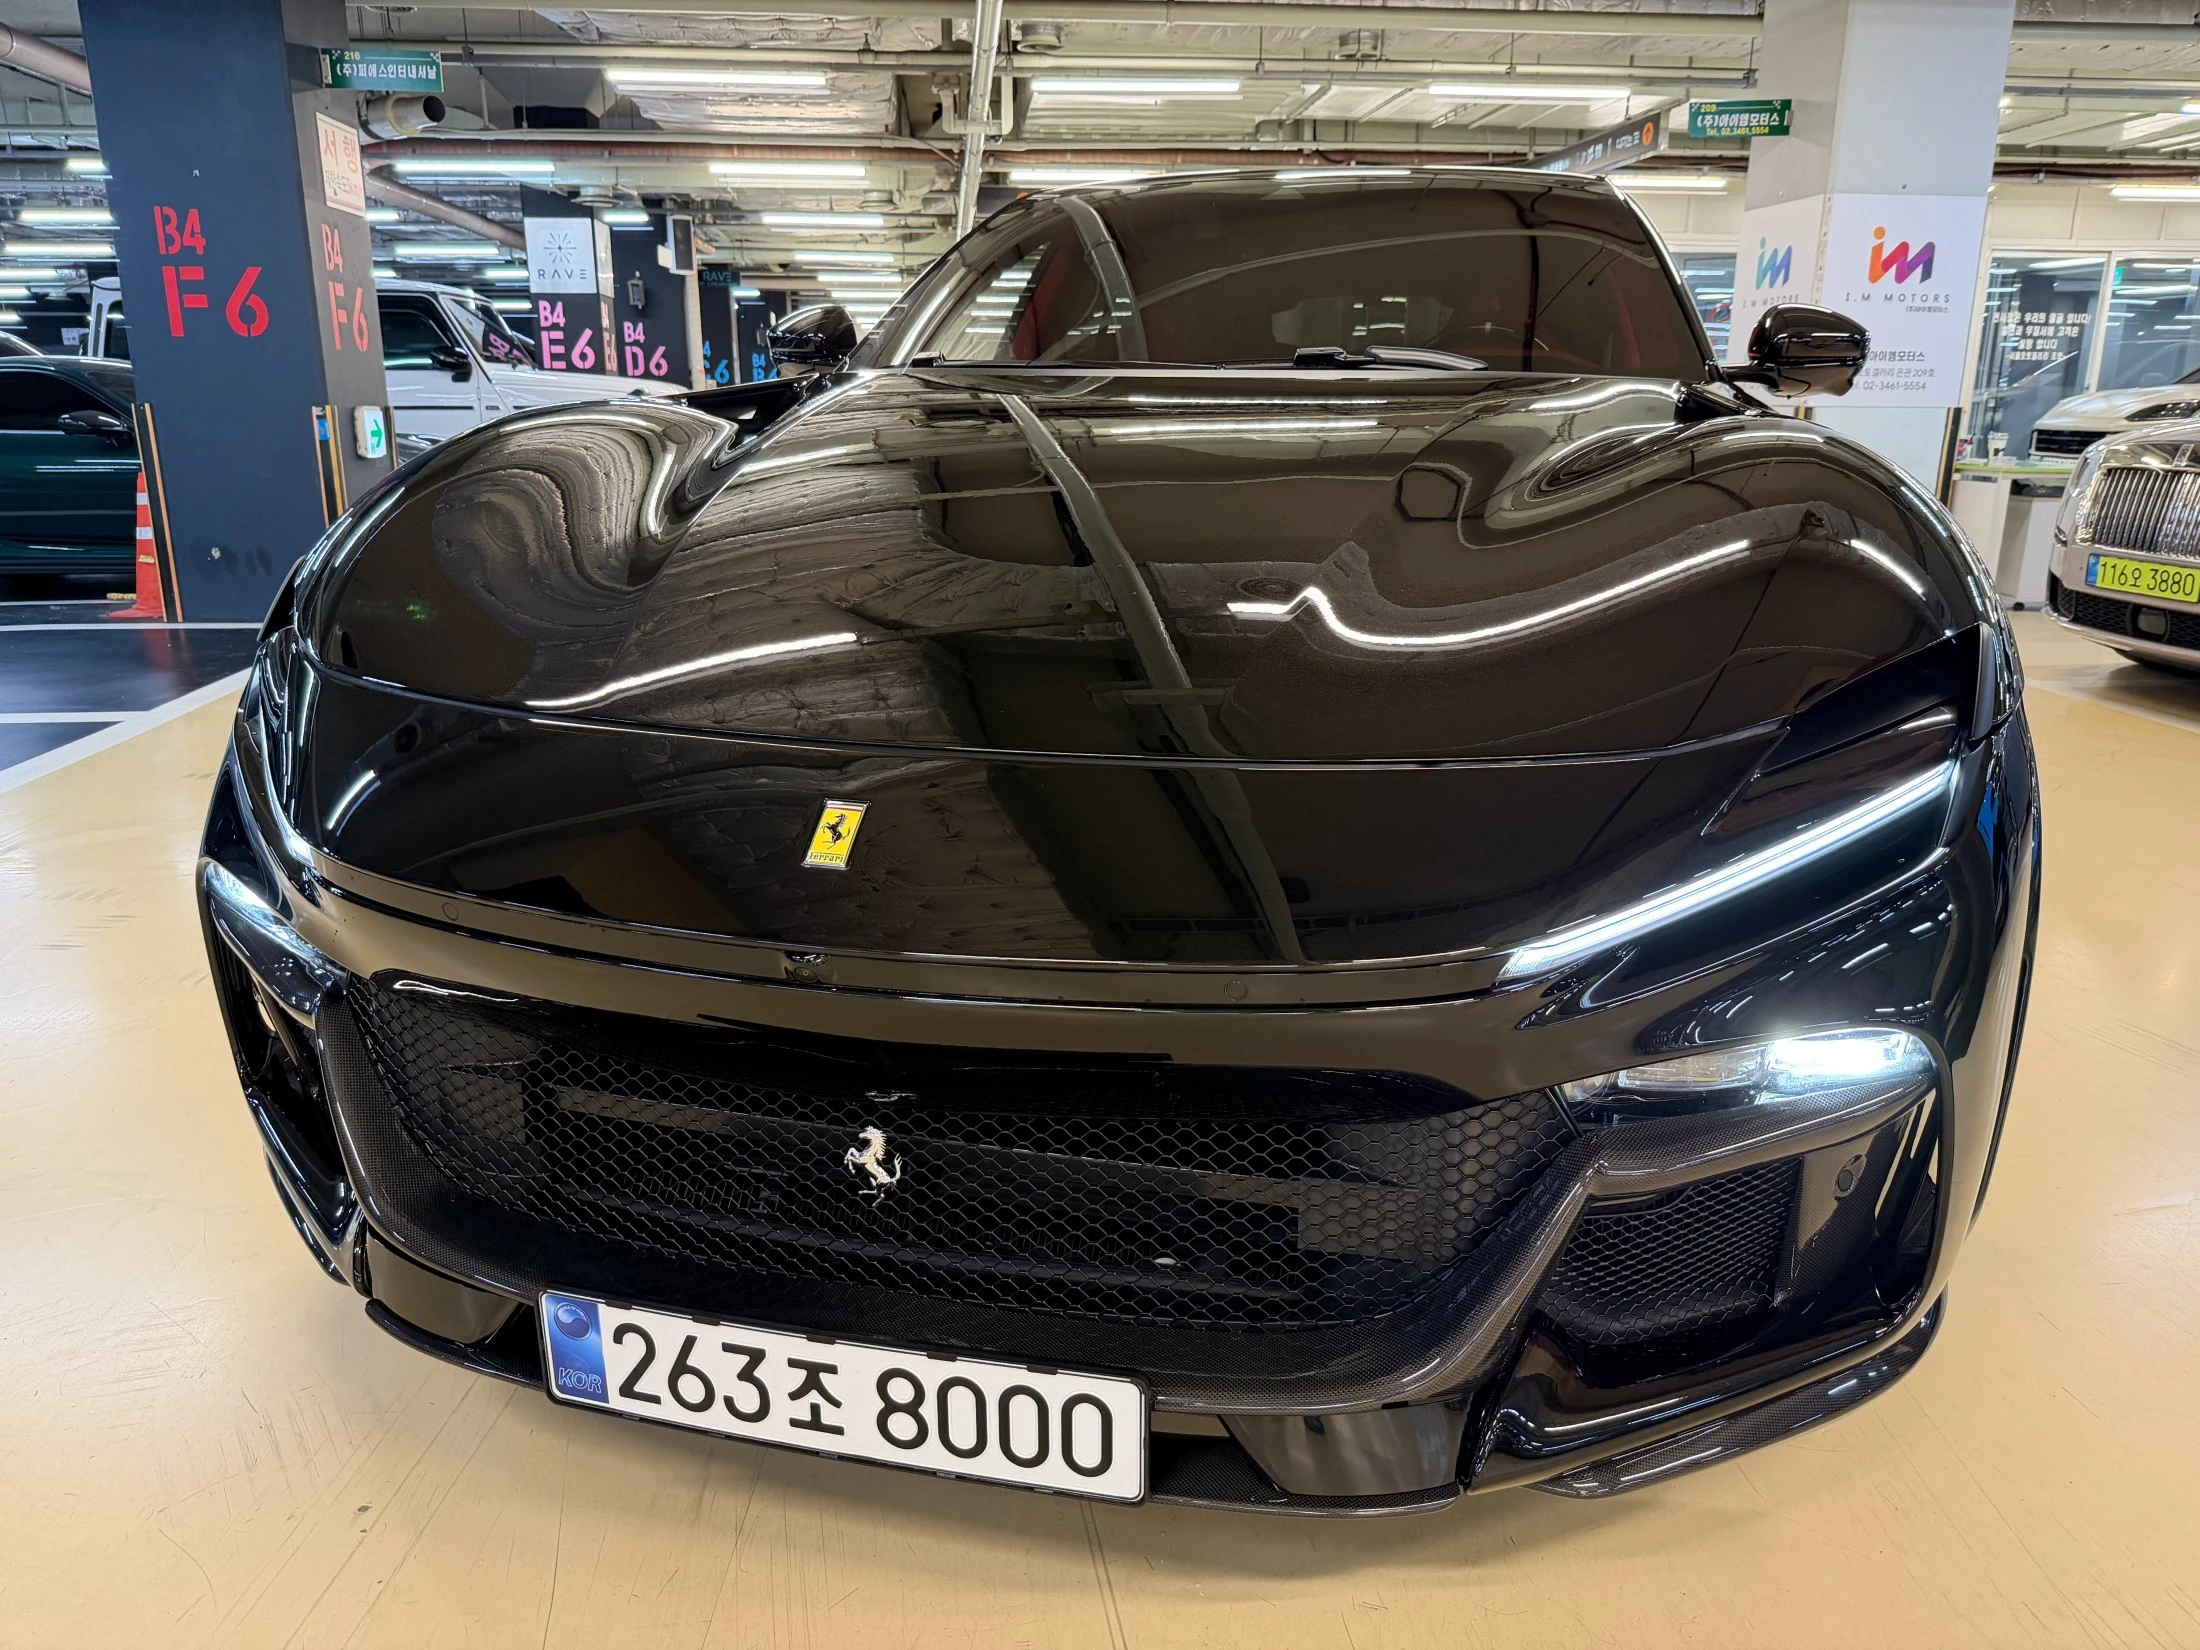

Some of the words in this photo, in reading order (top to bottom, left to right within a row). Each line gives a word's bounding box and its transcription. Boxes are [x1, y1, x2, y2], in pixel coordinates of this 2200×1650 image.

[344, 51, 360, 60] 216
[1700, 104, 1717, 113] 209
[154, 206, 206, 254] B4
[322, 224, 343, 274] B4
[538, 269, 587, 280] RAVE
[703, 271, 732, 281] RAVE
[1884, 293, 1950, 303] MOTORS
[538, 300, 565, 327] B4
[623, 322, 645, 343] B4
[541, 328, 595, 369] E6
[625, 346, 669, 377] D6
[752, 353, 766, 368] B4
[1863, 381, 1926, 390] 02-3461-5554
[2147, 568, 2196, 597] 3880
[809, 852, 845, 863] Ferrari
[558, 1367, 602, 1394] KOR
[612, 1321, 845, 1437] 263조
[874, 1366, 1114, 1478] 8000
